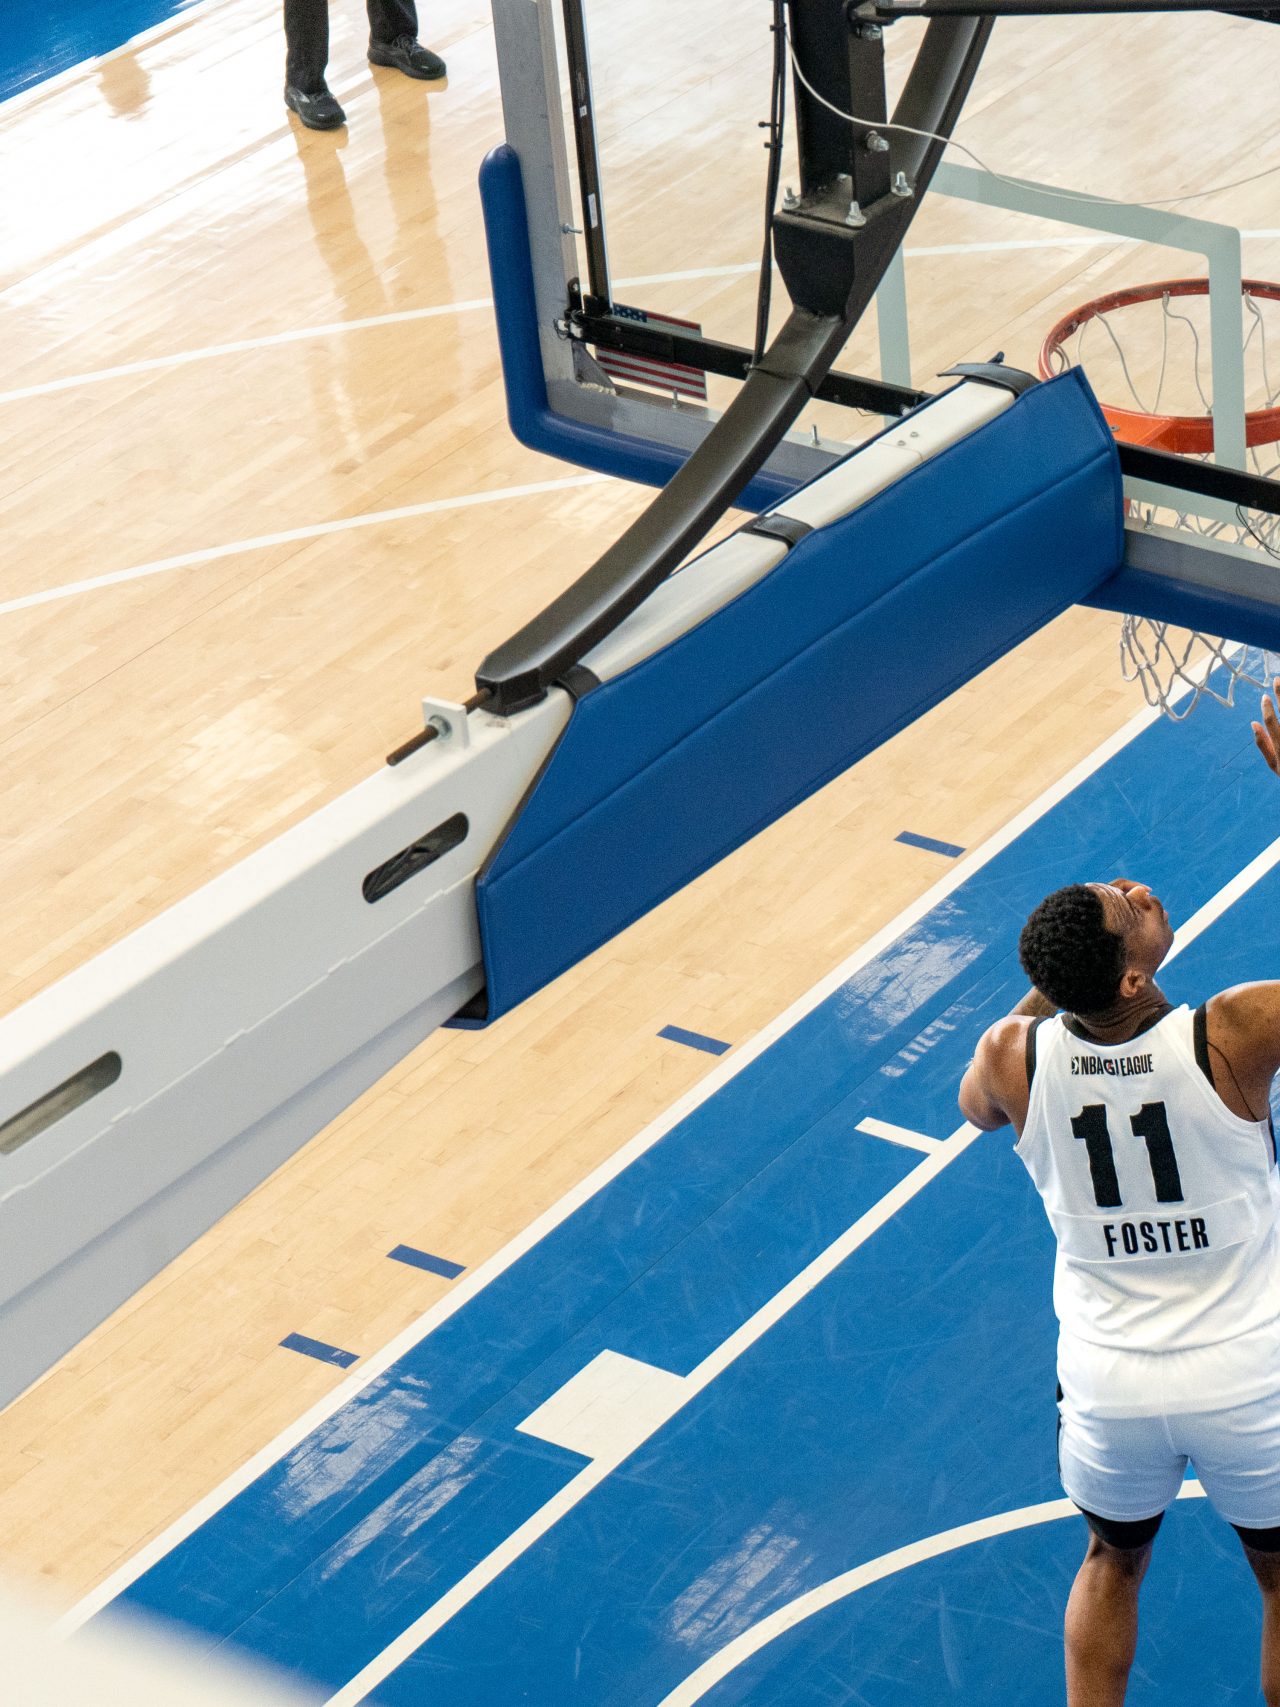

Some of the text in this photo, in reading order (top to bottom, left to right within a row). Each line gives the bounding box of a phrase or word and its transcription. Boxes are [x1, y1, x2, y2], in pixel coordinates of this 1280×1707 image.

[1081, 1056, 1104, 1075] NBA
[1070, 1100, 1185, 1208] 11
[1102, 1217, 1210, 1258] FOSTER
